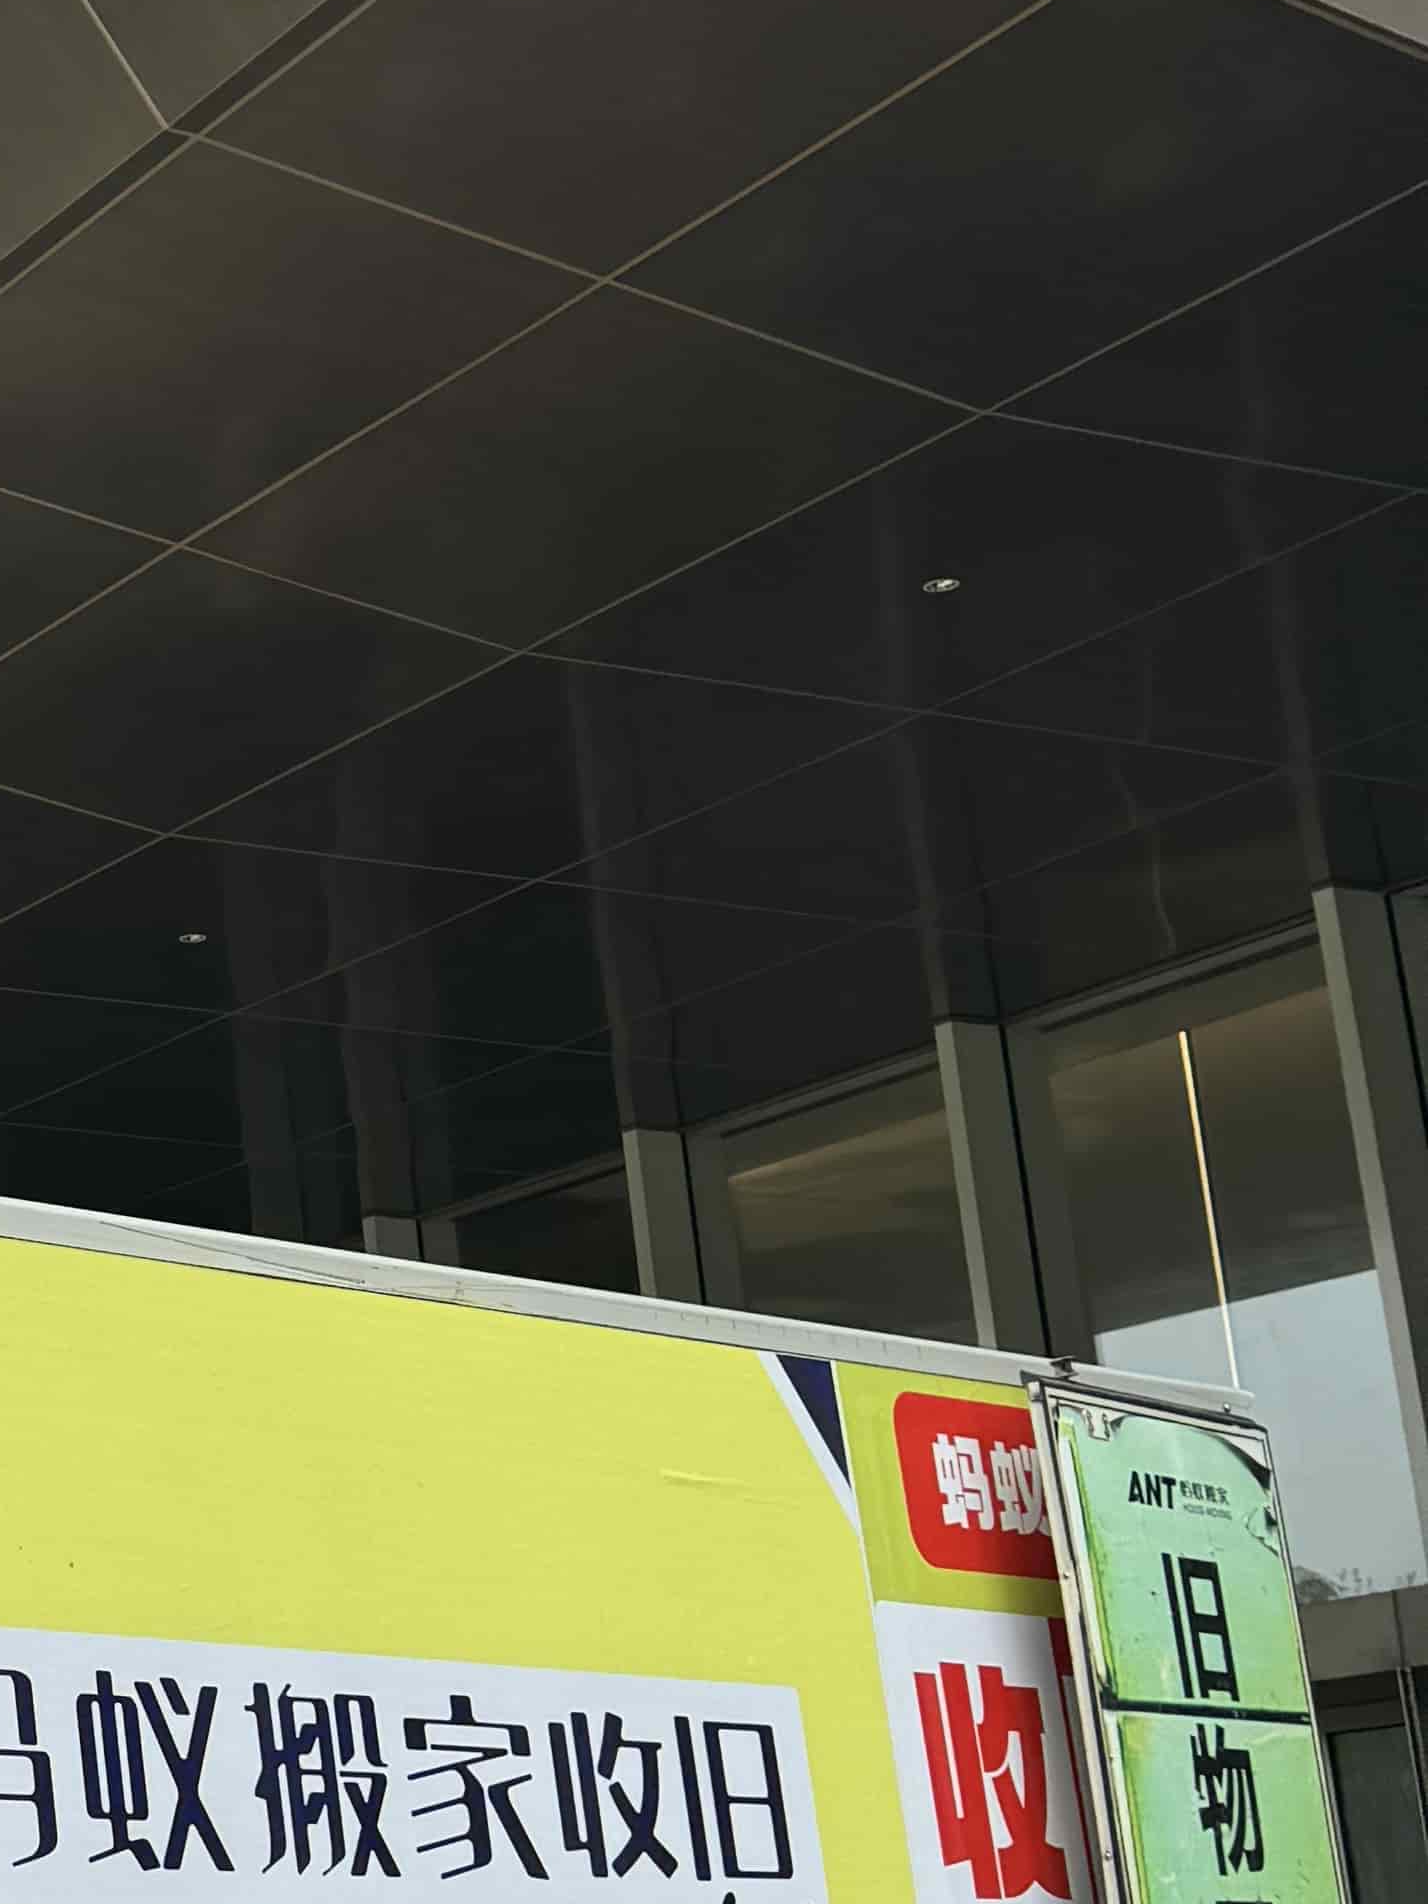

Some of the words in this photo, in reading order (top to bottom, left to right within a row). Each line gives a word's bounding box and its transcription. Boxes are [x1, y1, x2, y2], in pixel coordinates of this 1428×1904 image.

[931, 1432, 1050, 1534] 蚂蚁
[1128, 1470, 1176, 1510] ANT
[913, 1661, 1072, 1900] 收
